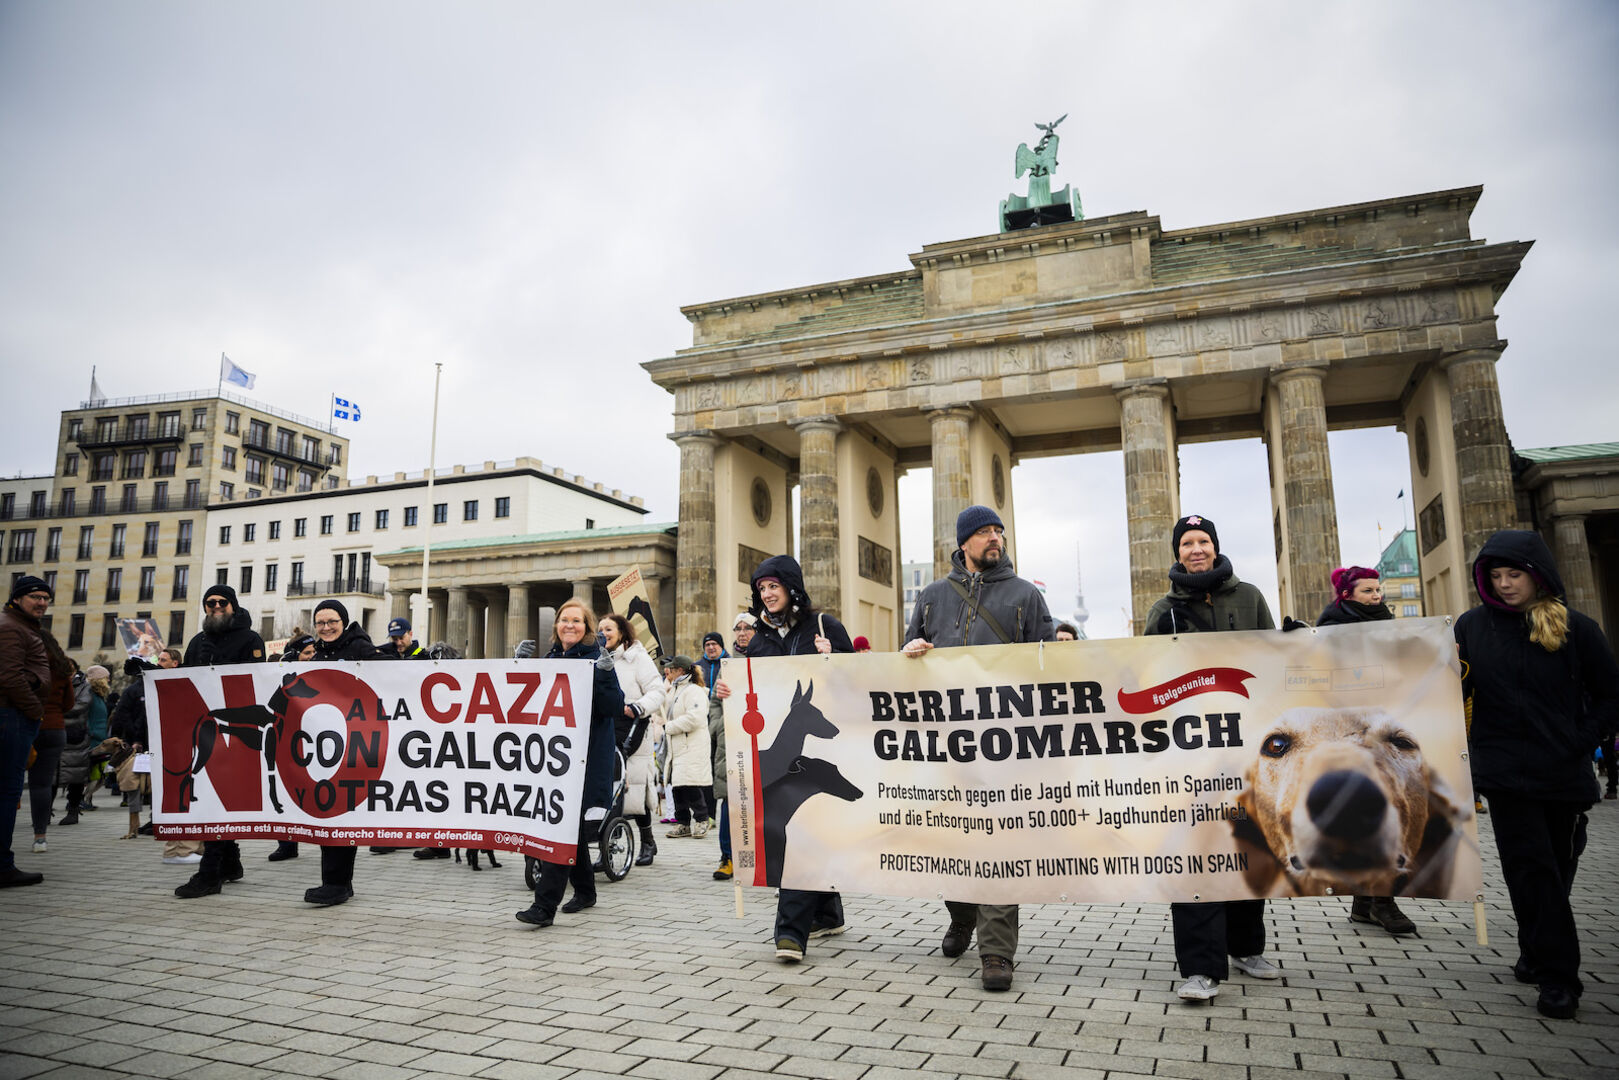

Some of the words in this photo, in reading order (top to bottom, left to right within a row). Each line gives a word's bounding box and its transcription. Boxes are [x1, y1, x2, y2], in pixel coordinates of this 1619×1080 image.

[346, 698, 367, 721] A
[376, 698, 412, 721] LA
[420, 672, 577, 727] CAZA
[869, 681, 1106, 723] BERLINER
[1152, 674, 1216, 705] #galgosunited
[290, 730, 379, 768] CON
[398, 731, 571, 776] GALGOS
[873, 712, 1244, 763] GALGOMARSCH
[314, 779, 450, 812] OTRAS
[464, 782, 565, 825] RAZAS
[736, 751, 748, 846] www.berliner-galgomarsch.de
[878, 782, 963, 803] Protestmarsch
[965, 787, 1006, 808] gegen
[1010, 783, 1034, 801] die
[1036, 783, 1072, 804] Jagd
[1076, 780, 1100, 798] mit
[1104, 777, 1162, 797] Hunden
[1165, 777, 1180, 794] in
[1183, 773, 1243, 799] Spanien
[158, 825, 183, 834] Cuanto
[184, 824, 203, 834] más
[204, 824, 252, 834] indefensa
[253, 823, 272, 834] está
[273, 825, 286, 834] una
[287, 826, 314, 838] criatura,
[314, 828, 330, 839] más
[331, 828, 374, 840] derecho
[377, 828, 403, 840] tiene
[405, 830, 413, 840] a
[414, 830, 432, 840] ser
[433, 830, 484, 842] defendida
[879, 809, 901, 826] und
[904, 810, 924, 826] die
[925, 810, 995, 835] Entsorgung
[998, 817, 1024, 831] von
[1028, 807, 1091, 829] 50.000+
[1095, 807, 1187, 830] Jagdhunden
[1191, 802, 1248, 826] jährlich
[879, 852, 972, 878] PROTESTMARCH
[974, 859, 1033, 880] AGAINST
[1036, 857, 1100, 877] HUNTING
[1103, 856, 1142, 876] WITH
[1144, 855, 1185, 874] DOGS
[1187, 854, 1203, 873] IN
[1207, 851, 1249, 873] SPAIN
